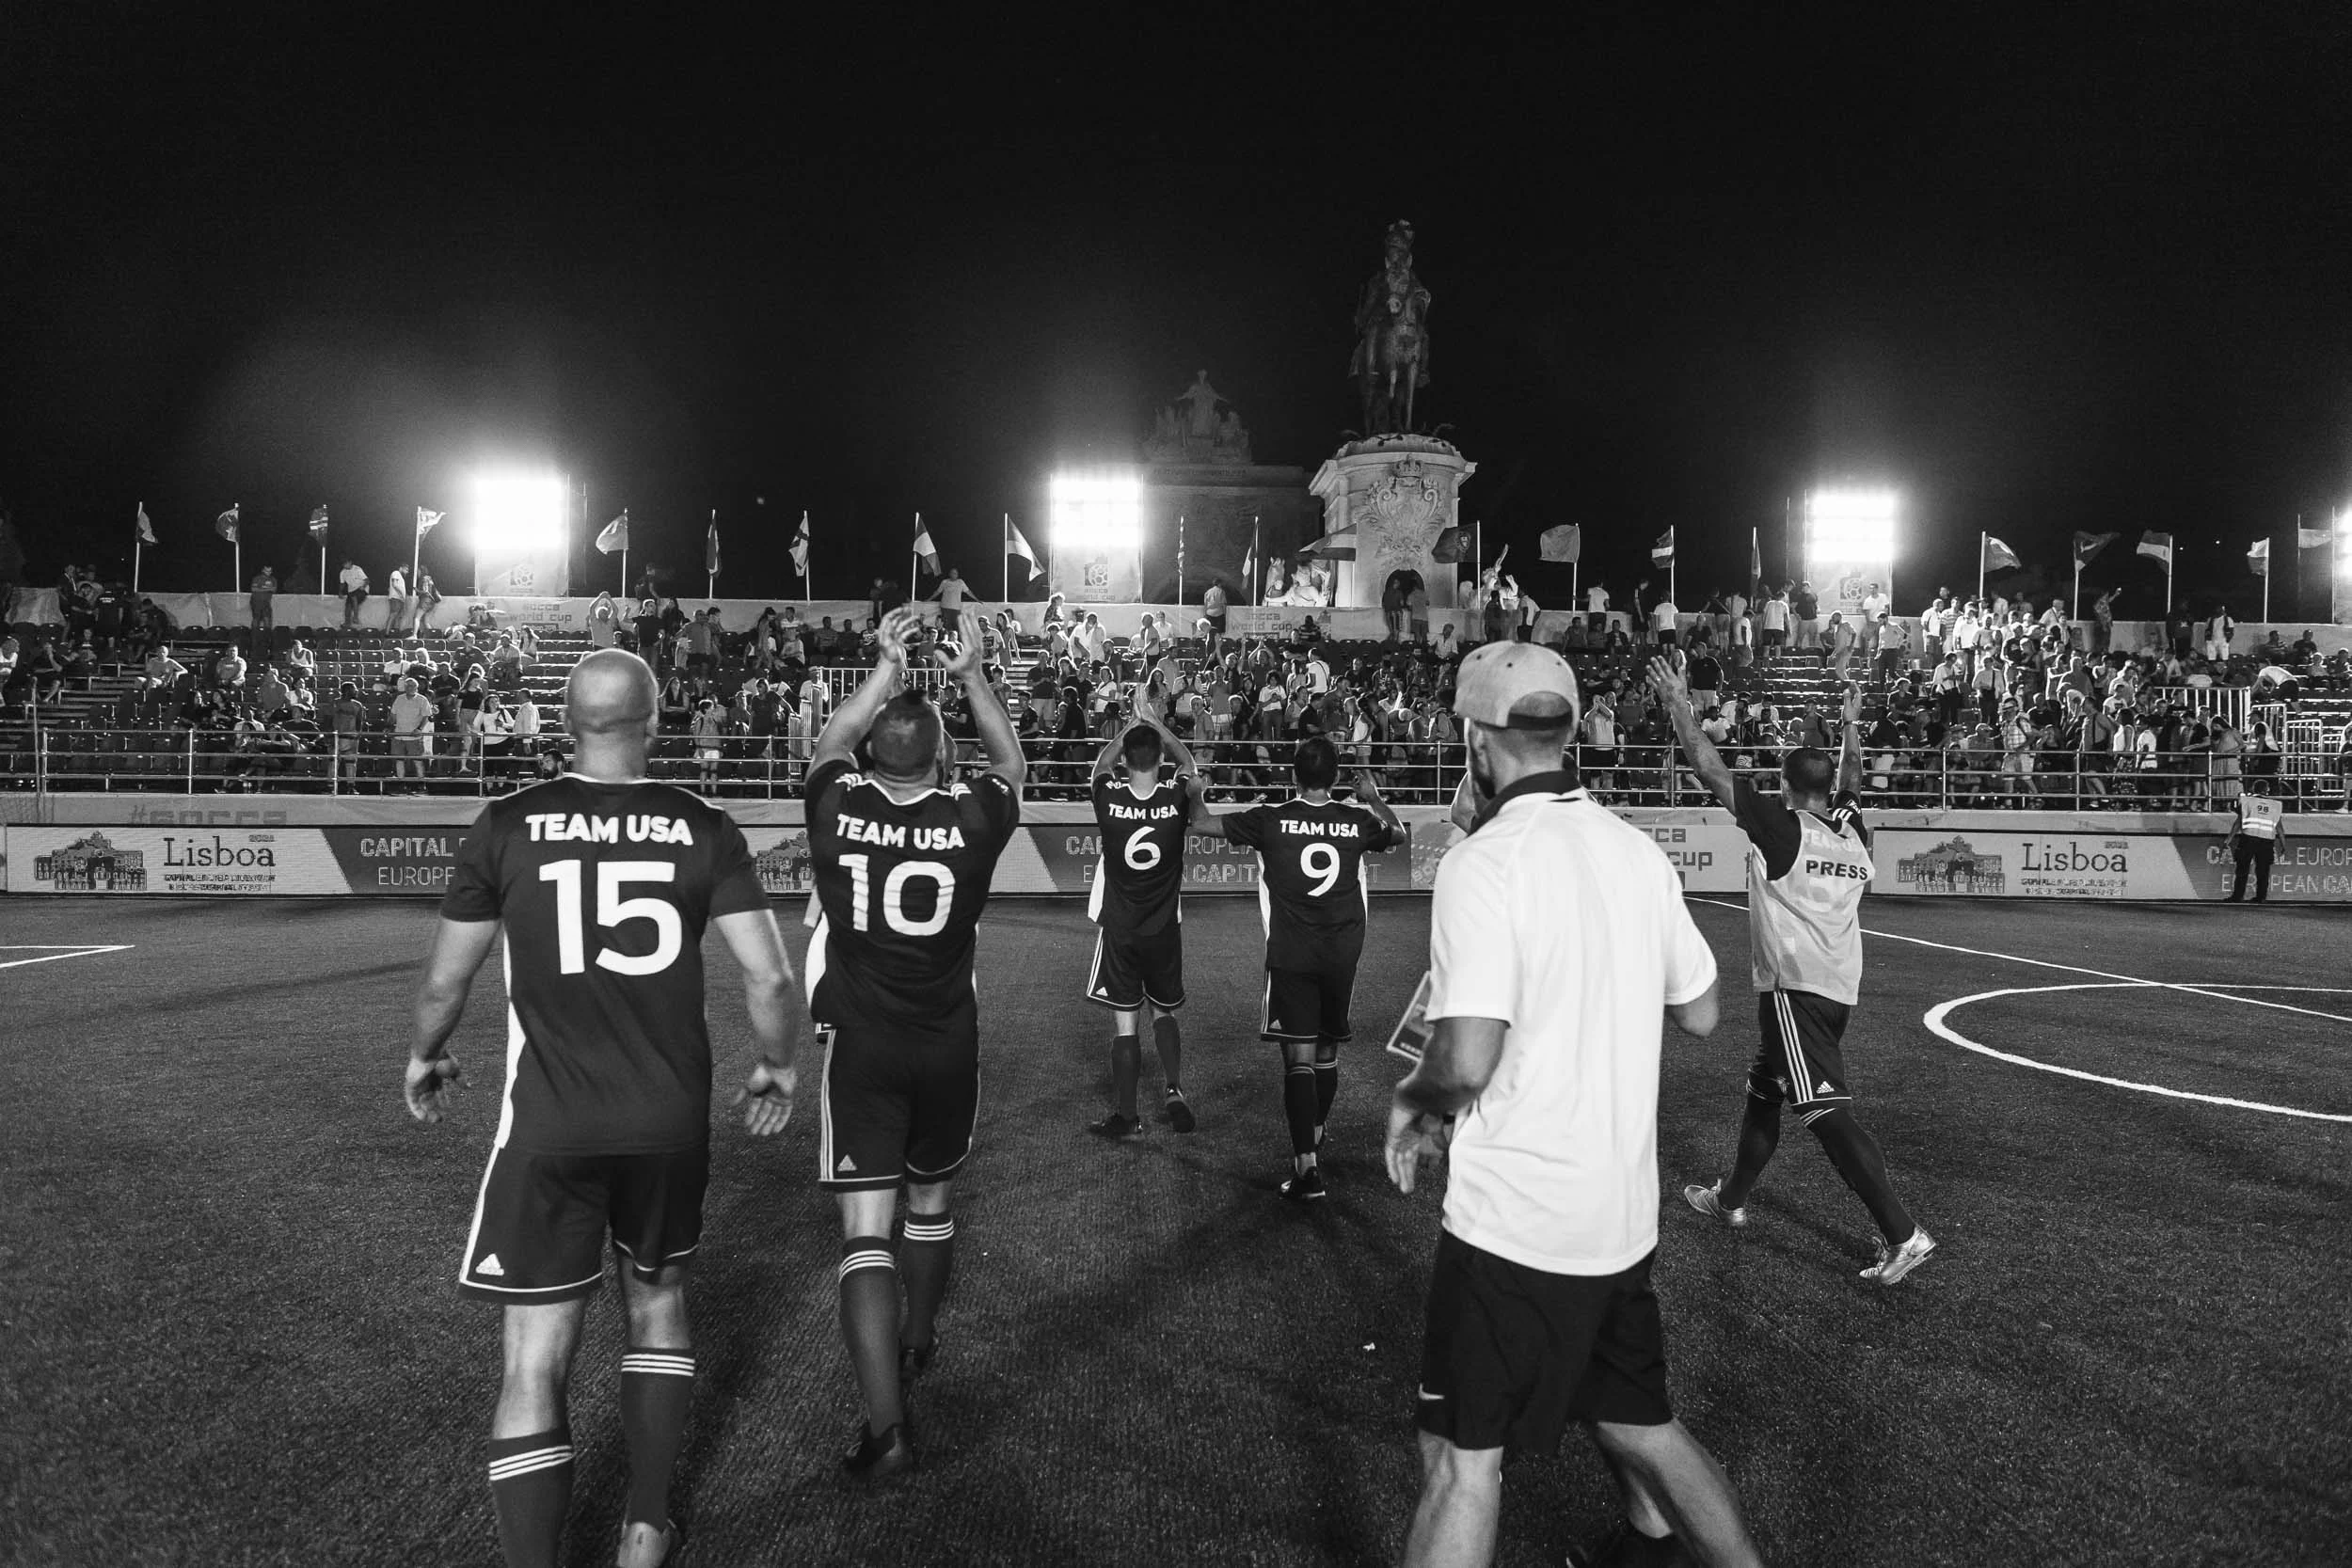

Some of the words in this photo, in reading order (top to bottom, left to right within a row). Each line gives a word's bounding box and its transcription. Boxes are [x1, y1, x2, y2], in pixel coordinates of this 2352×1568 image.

[1108, 802, 1147, 820] TEAM
[1150, 804, 1179, 820] USA
[525, 813, 619, 844] TEAM
[627, 815, 693, 846] USA
[836, 814, 906, 847] TEAM
[914, 826, 965, 850] USA
[1279, 819, 1325, 836] TEAM
[1328, 822, 1359, 838] USA
[163, 835, 277, 867] Lisboa
[360, 837, 454, 857] CAPITAL
[1124, 826, 1161, 871] 6
[2022, 842, 2128, 873] Lisboa
[1193, 863, 1259, 883] CAPIT
[1300, 843, 1340, 897] 9
[1805, 859, 1868, 880] PRESS
[838, 853, 956, 937] 10
[539, 859, 682, 976] 15
